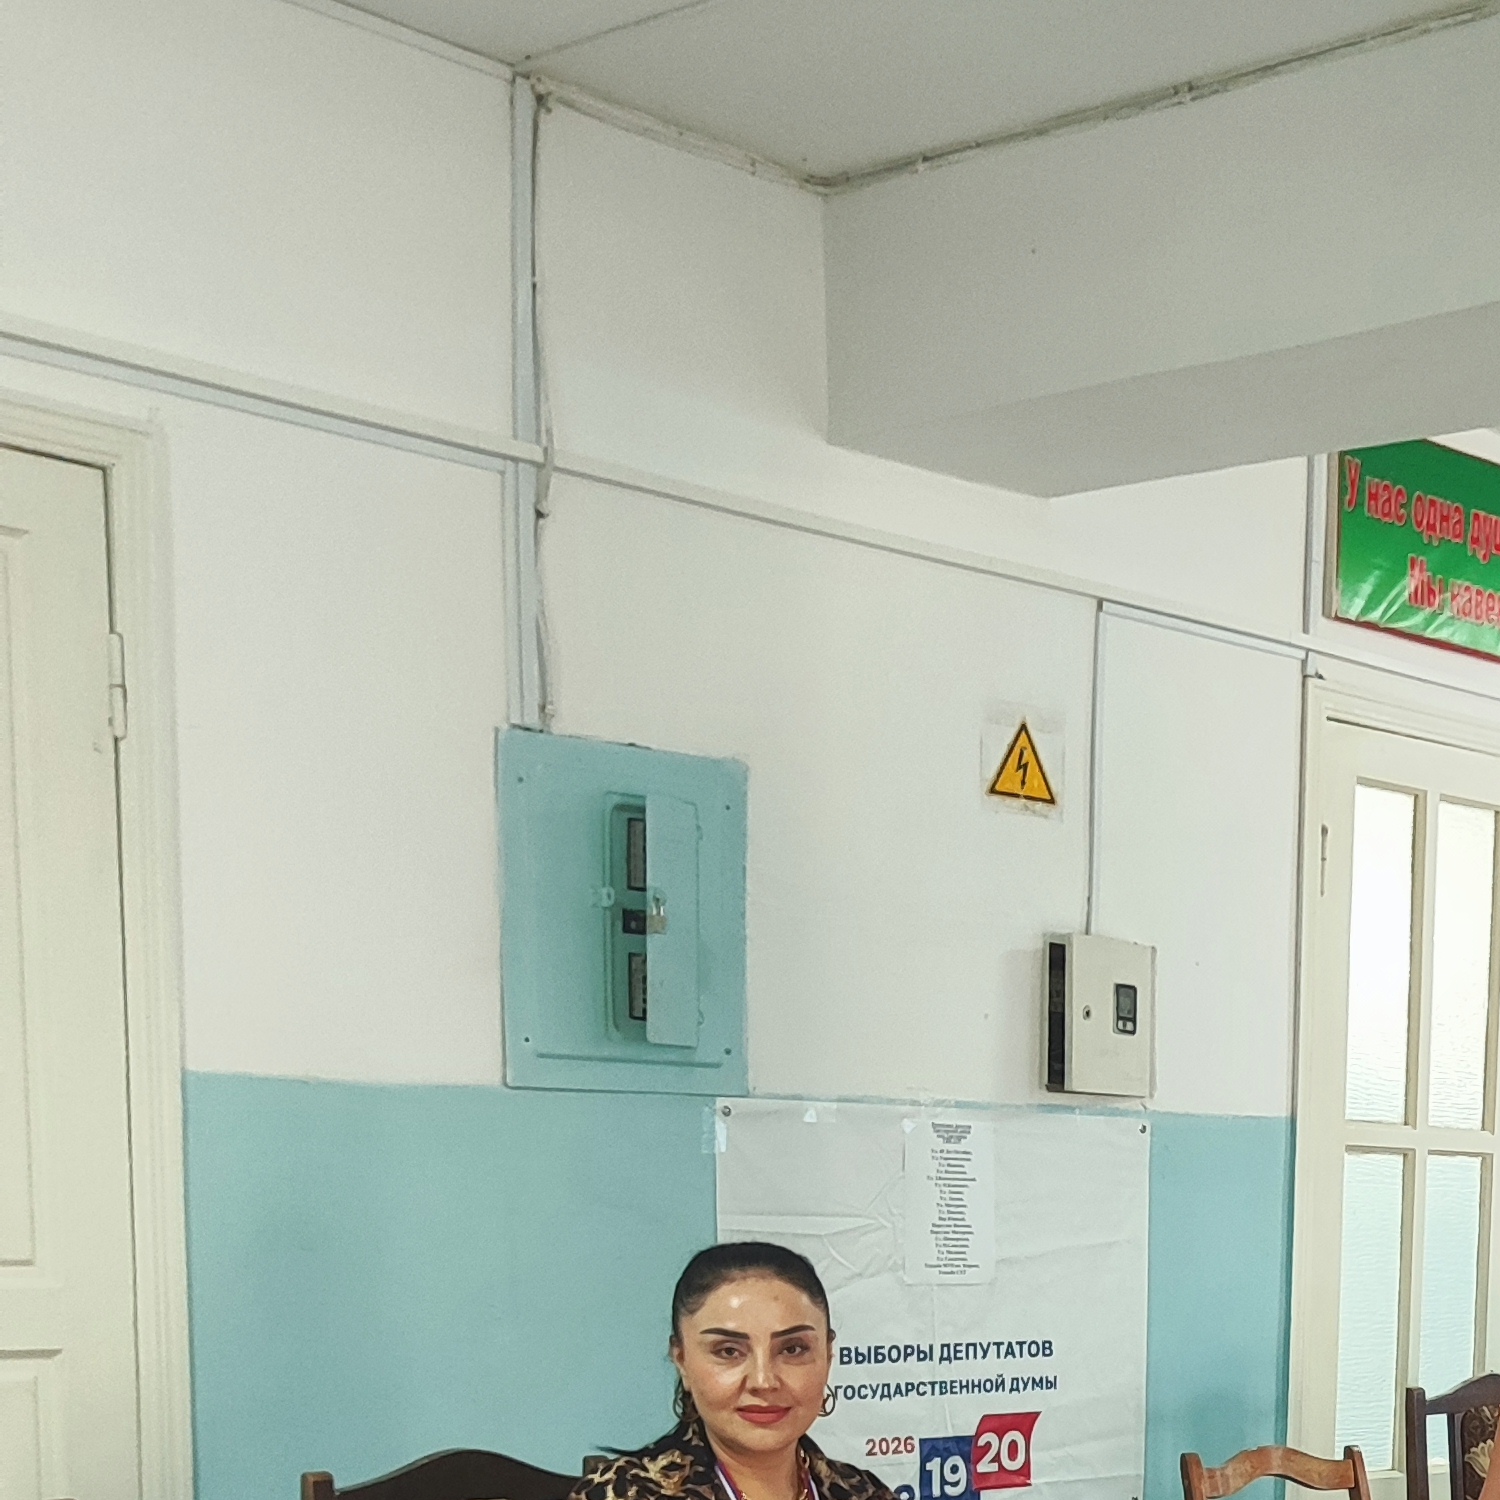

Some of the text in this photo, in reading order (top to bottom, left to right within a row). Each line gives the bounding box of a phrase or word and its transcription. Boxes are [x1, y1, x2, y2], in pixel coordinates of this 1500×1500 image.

[1344, 455, 1361, 512] У
[1365, 476, 1407, 526] нас
[1412, 491, 1464, 546] одна
[1408, 553, 1444, 613] Мы
[839, 1340, 1053, 1365] ВЫБОРЫ ДЕПУТАТОВ
[834, 1374, 1057, 1401] ГОСУДАРСТВЕННОЙ ДУМЫ
[866, 1436, 915, 1456] 2026
[975, 1430, 1026, 1473] 20
[925, 1455, 967, 1498] 19
